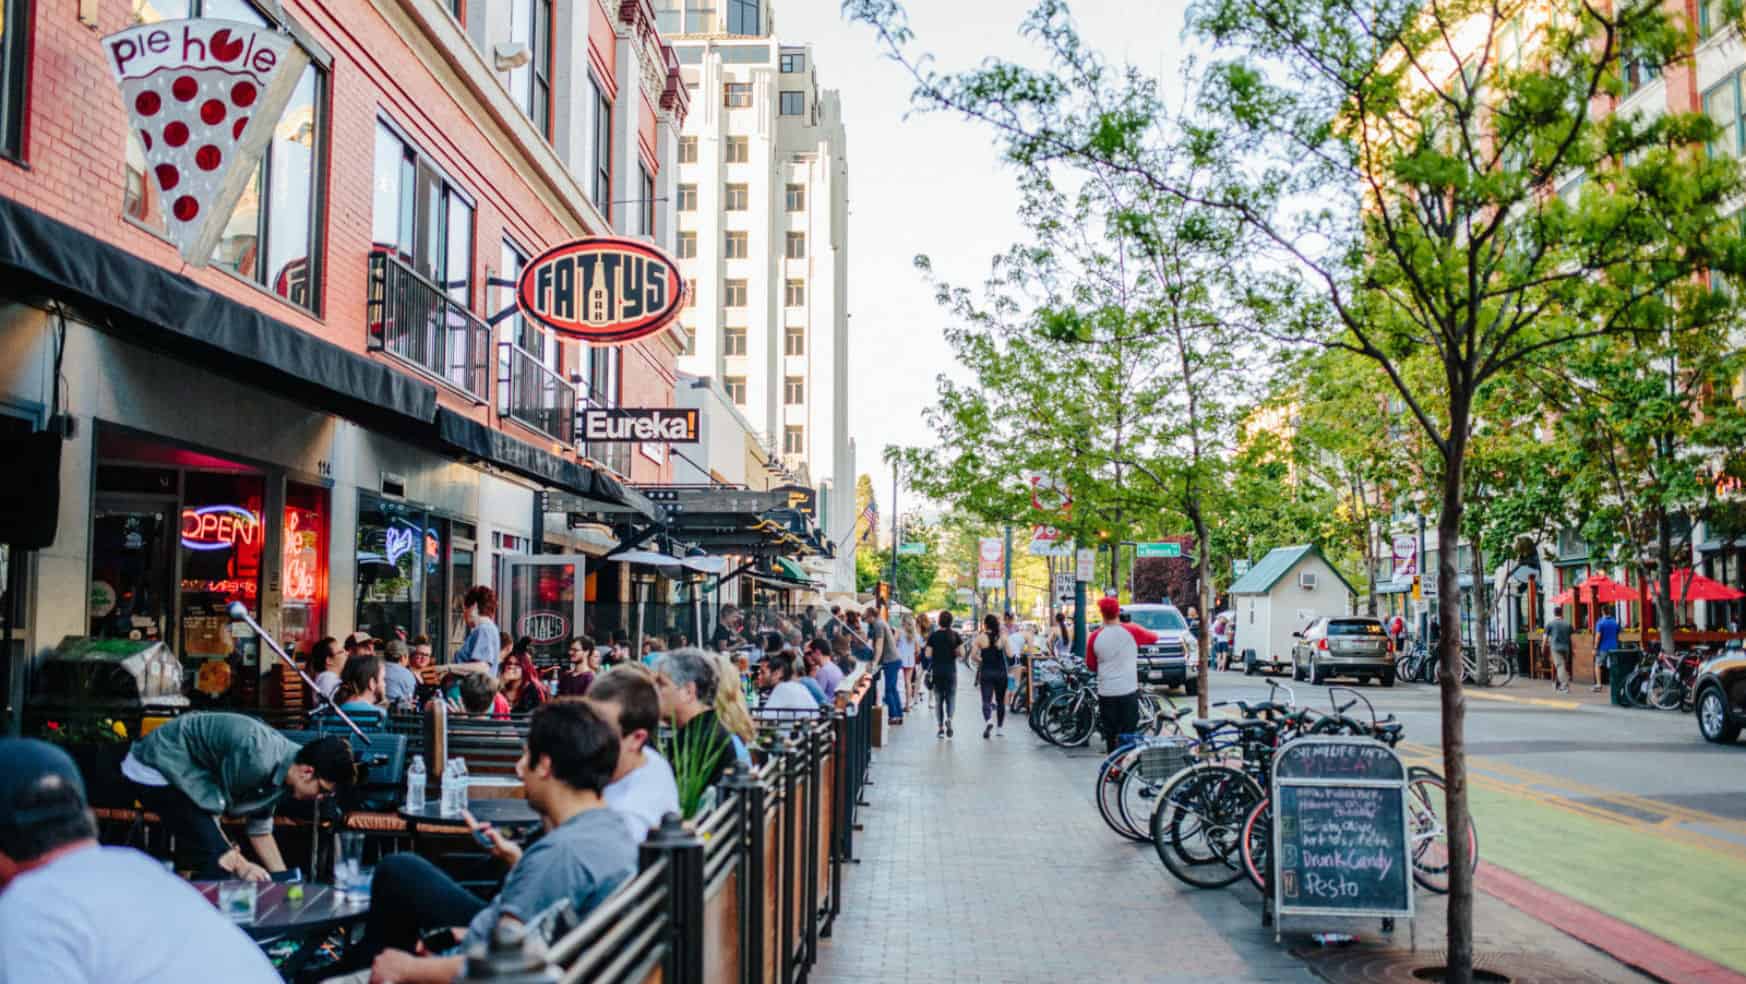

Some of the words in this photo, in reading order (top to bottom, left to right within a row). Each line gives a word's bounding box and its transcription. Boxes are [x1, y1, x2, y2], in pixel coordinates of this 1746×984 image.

[111, 30, 171, 74] pie
[182, 26, 276, 73] hole
[537, 252, 666, 321] FATTYS
[594, 289, 603, 321] BAR
[586, 411, 695, 438] Eureka!
[181, 510, 254, 545] OPEN
[1304, 872, 1360, 898] Pesto
